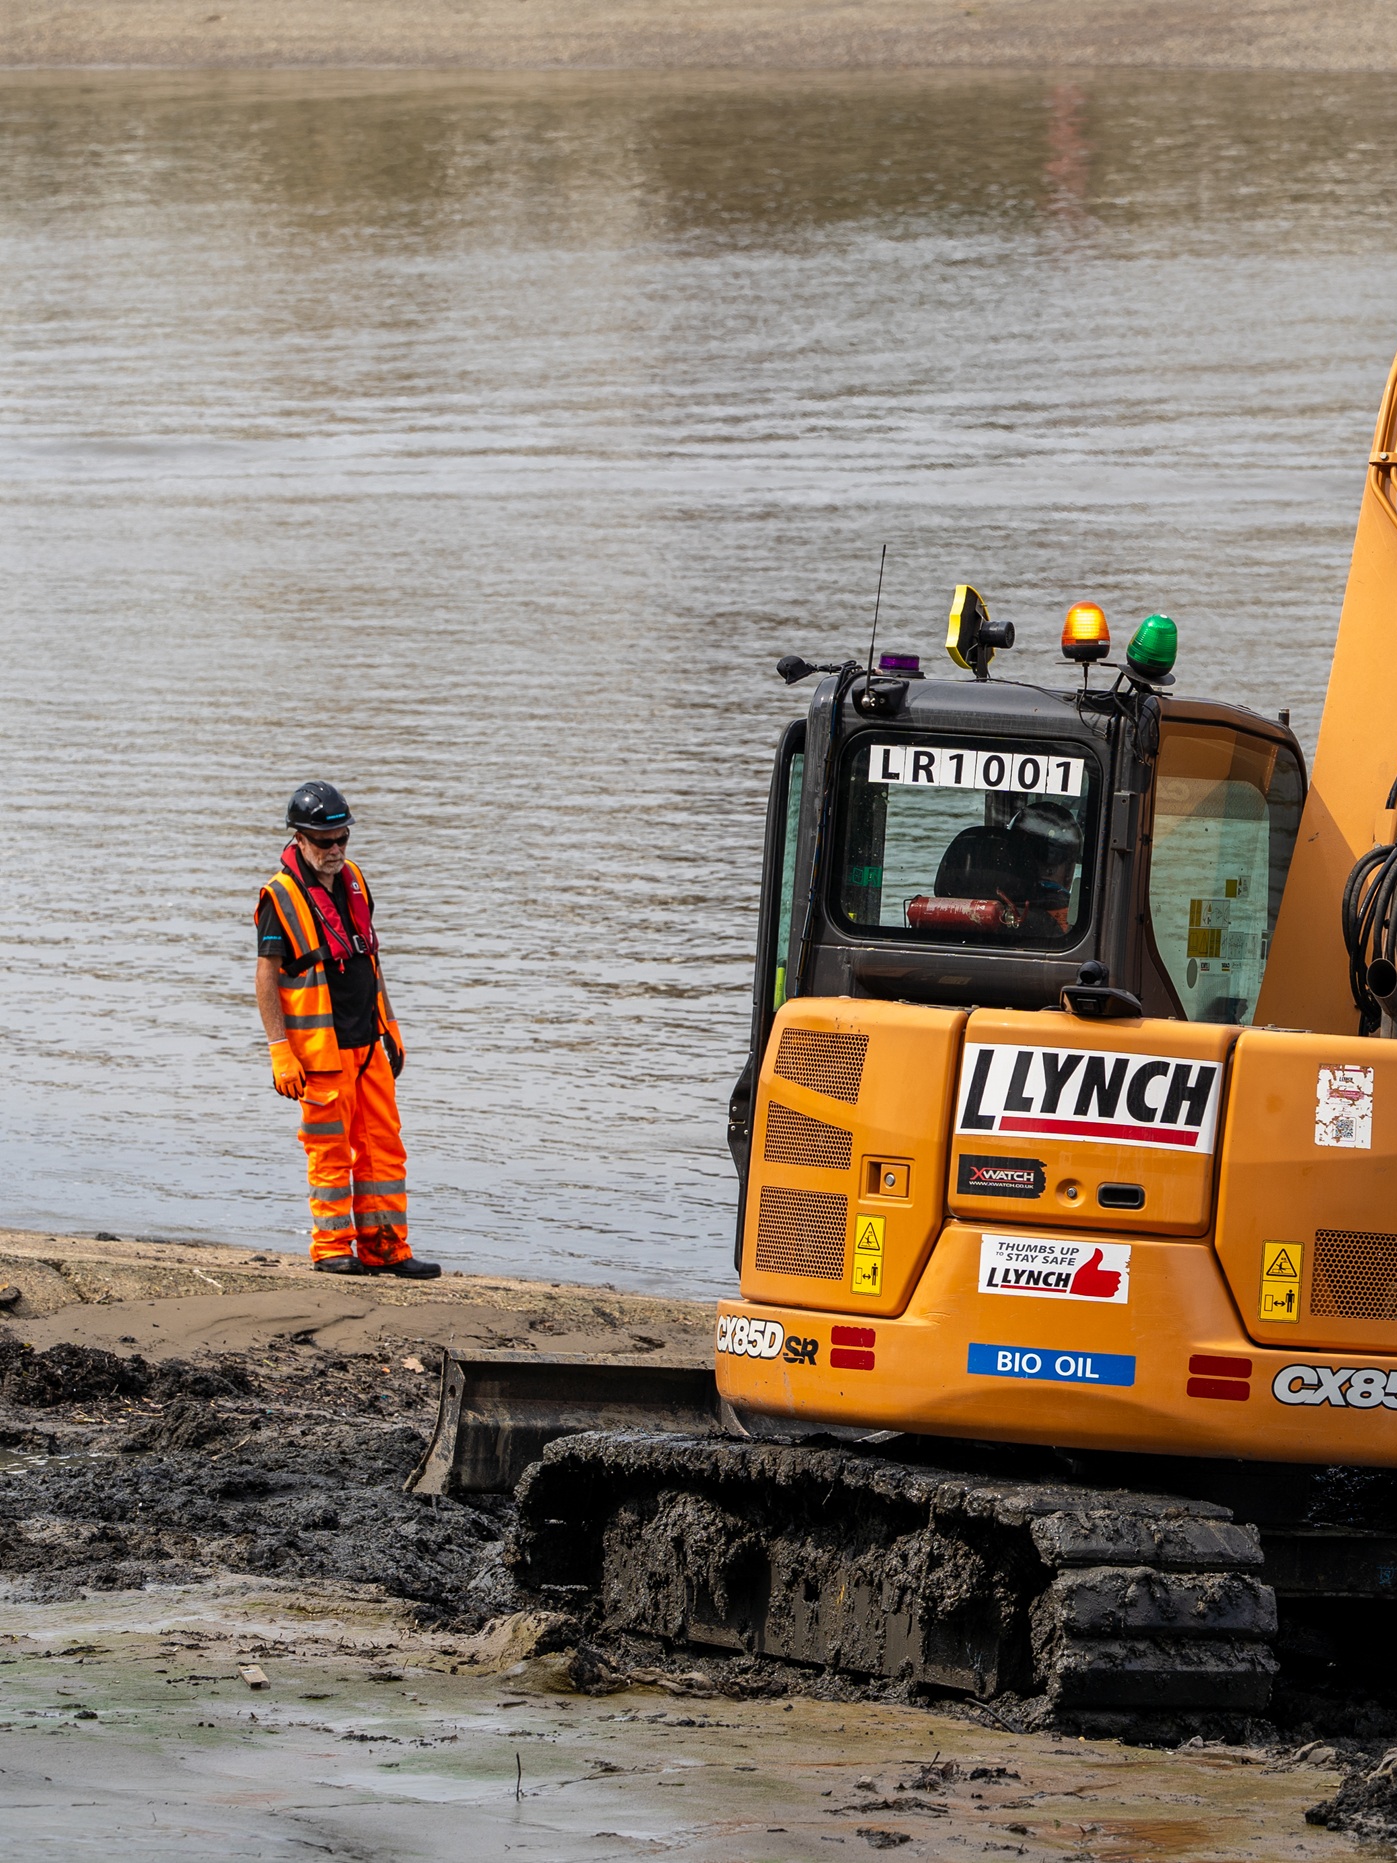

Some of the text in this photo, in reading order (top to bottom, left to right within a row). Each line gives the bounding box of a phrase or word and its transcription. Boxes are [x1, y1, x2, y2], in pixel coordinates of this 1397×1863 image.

[881, 748, 1071, 793] LR1001
[970, 1166, 1034, 1184] XWATCH
[969, 1180, 1034, 1189] WWW.XWATCH.CO.UK
[998, 1242, 1079, 1256] THUMBS UP
[1006, 1252, 1038, 1263] STAY
[1042, 1257, 1076, 1266] SAFE
[717, 1315, 819, 1365] CX85D SR
[997, 1351, 1099, 1378] BIO OIL
